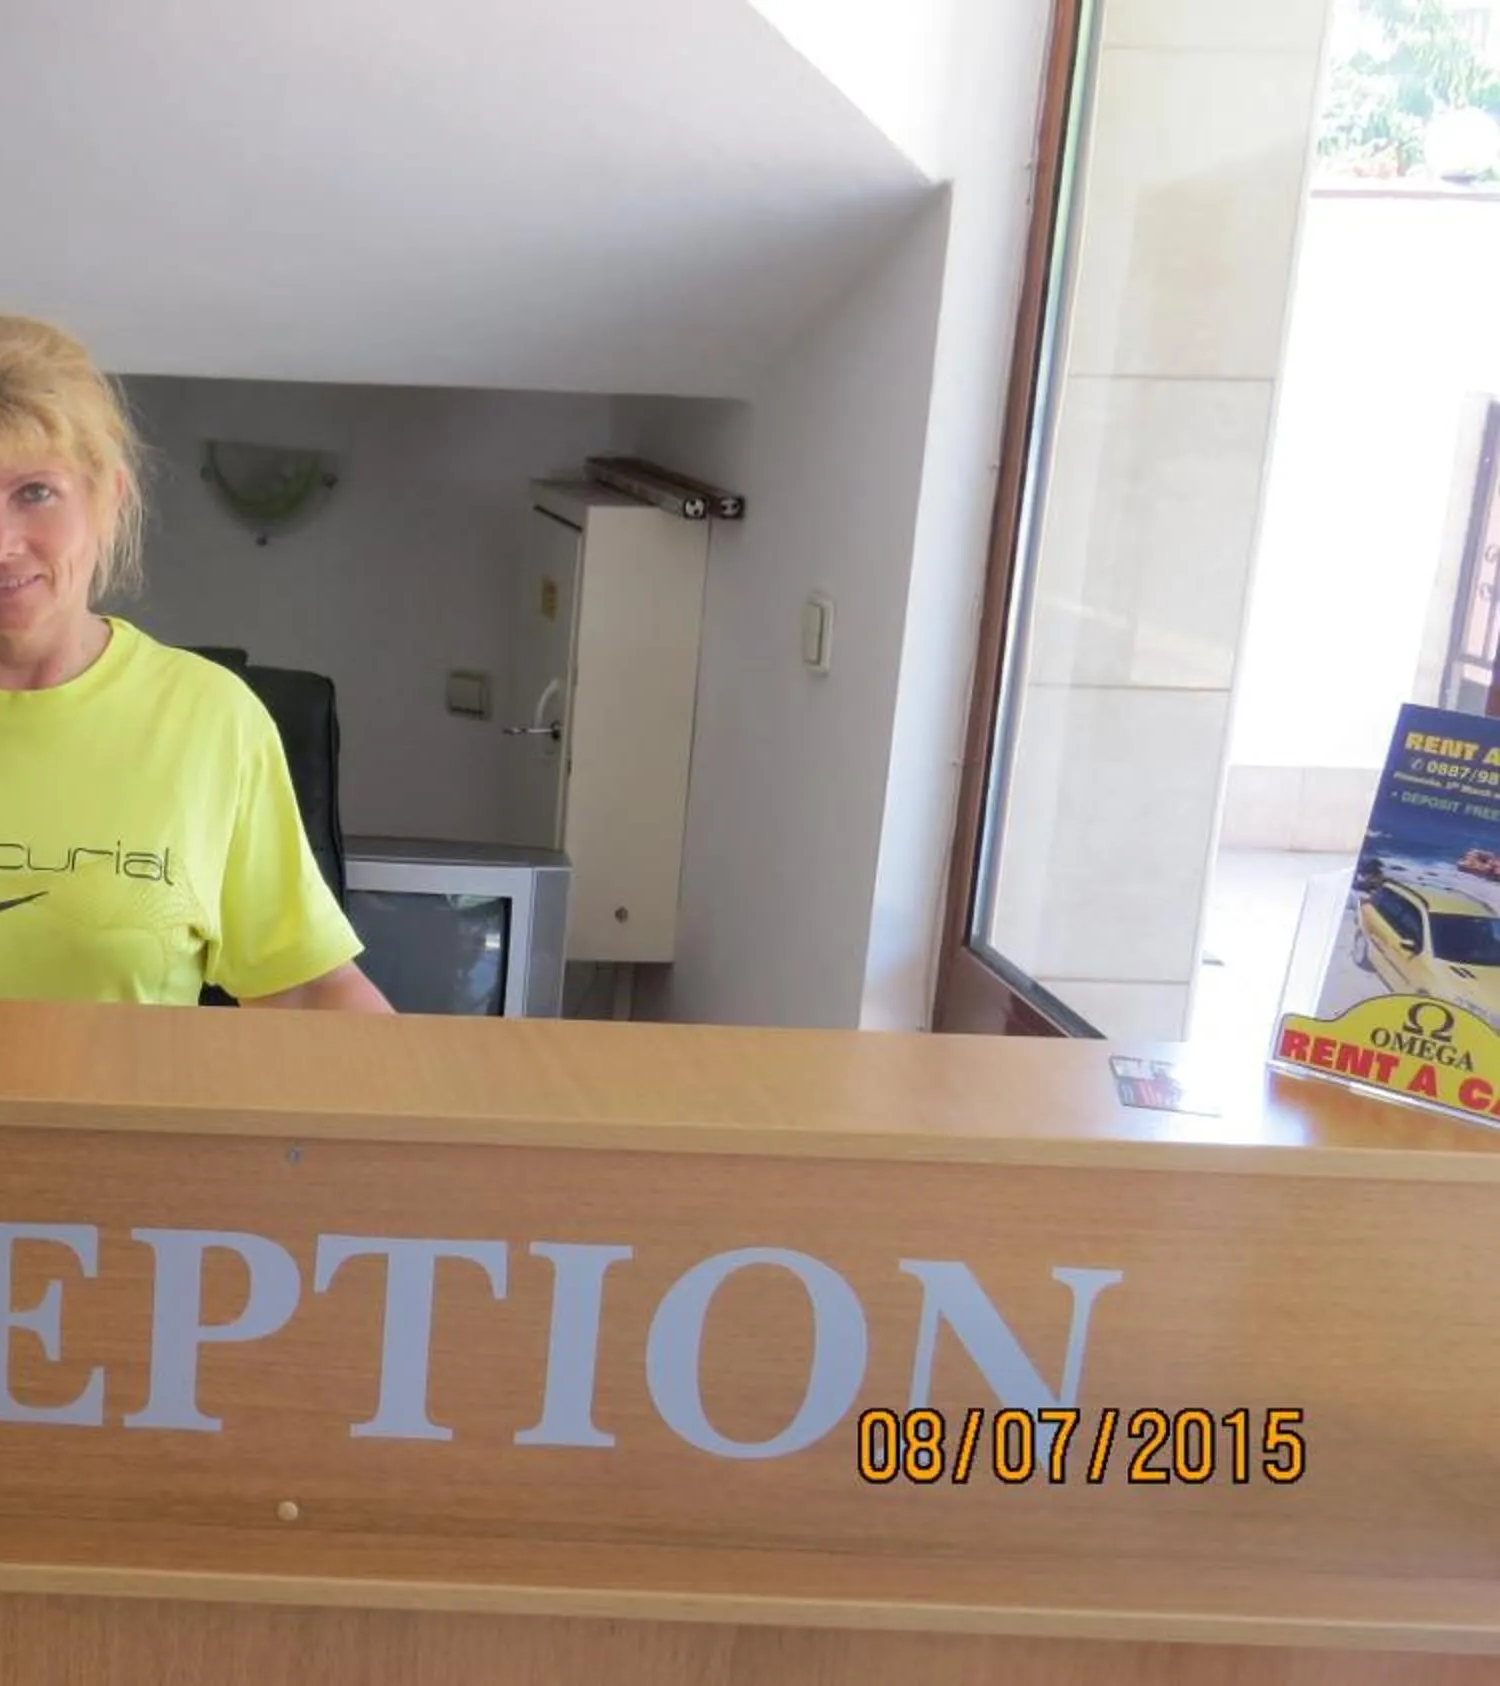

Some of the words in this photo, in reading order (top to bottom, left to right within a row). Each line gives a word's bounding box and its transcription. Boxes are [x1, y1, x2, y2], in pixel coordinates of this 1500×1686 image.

[1405, 732, 1479, 761] RENT
[1400, 791, 1461, 813] DEPOSIT
[1370, 1027, 1474, 1072] OMEGA
[1279, 1028, 1400, 1084] RENT
[1406, 1064, 1438, 1098] A
[1458, 1077, 1500, 1118] C
